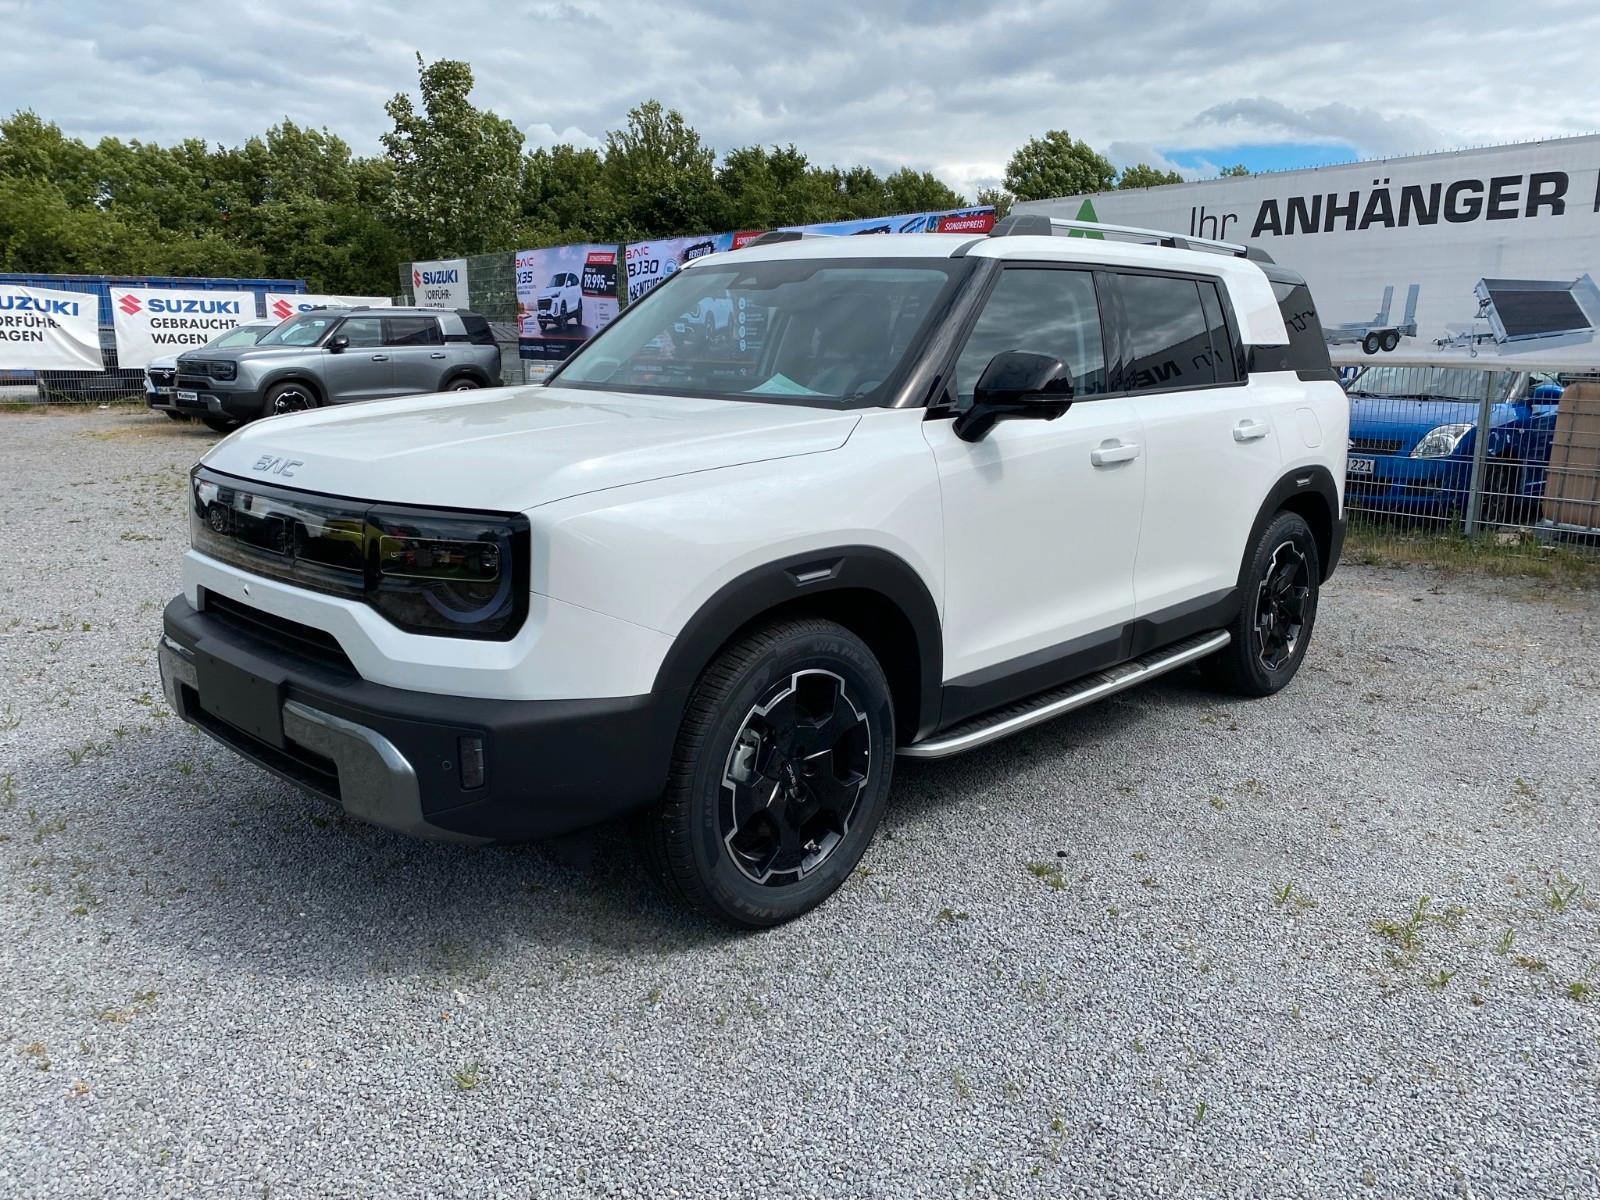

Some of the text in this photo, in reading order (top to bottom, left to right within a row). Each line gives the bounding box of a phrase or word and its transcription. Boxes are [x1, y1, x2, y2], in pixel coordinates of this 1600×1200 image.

[1190, 206, 1238, 240] Ihr
[1251, 170, 1569, 238] ANHÄNGER
[945, 220, 986, 231] SONDERPREIS!
[628, 260, 659, 277] BJ30
[422, 269, 458, 285] SUZUKI
[517, 271, 533, 284] X35
[148, 298, 240, 314] SUZUKI
[150, 317, 239, 330] GEBRAUCHT-
[151, 333, 208, 344] WAGEN
[252, 454, 305, 477] BAIC
[1350, 459, 1372, 472] 221
